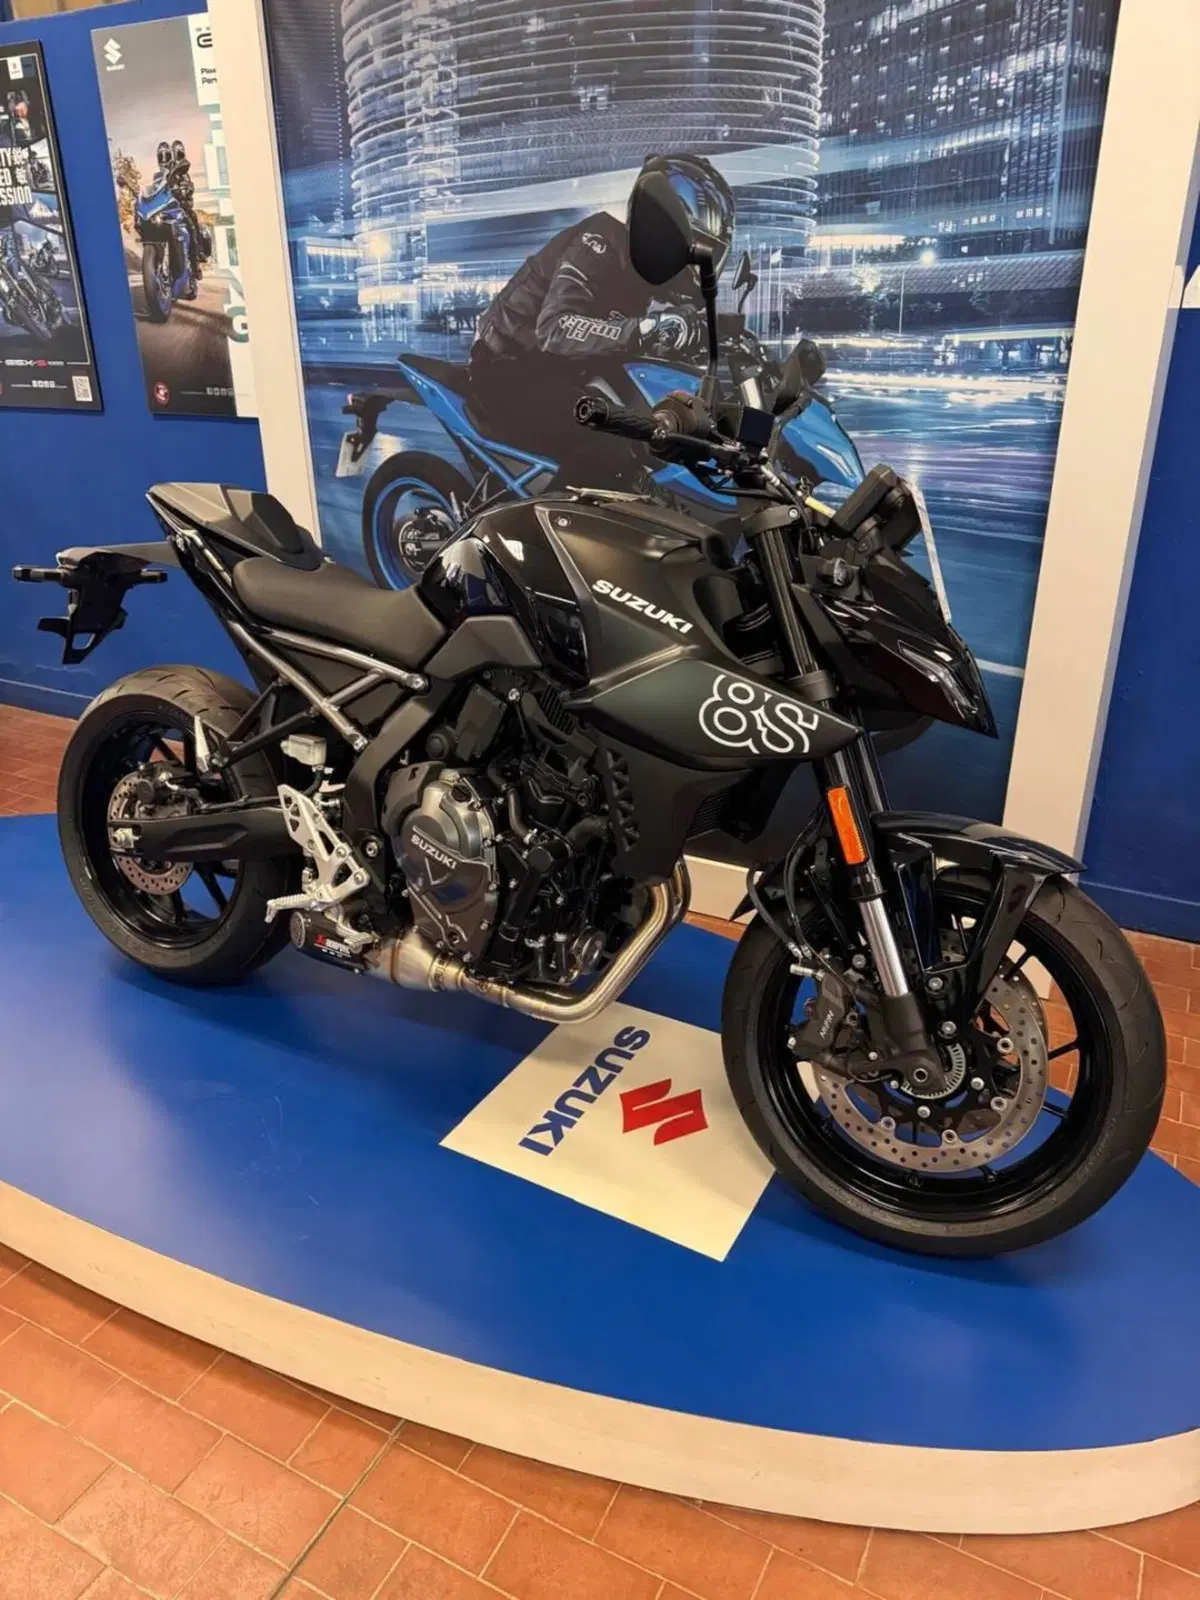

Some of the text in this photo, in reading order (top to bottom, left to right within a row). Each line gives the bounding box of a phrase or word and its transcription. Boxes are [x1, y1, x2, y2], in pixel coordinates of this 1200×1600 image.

[592, 579, 694, 634] SUZUKI
[411, 834, 457, 869] SUZUKI
[518, 1025, 650, 1157] SUZUKI
